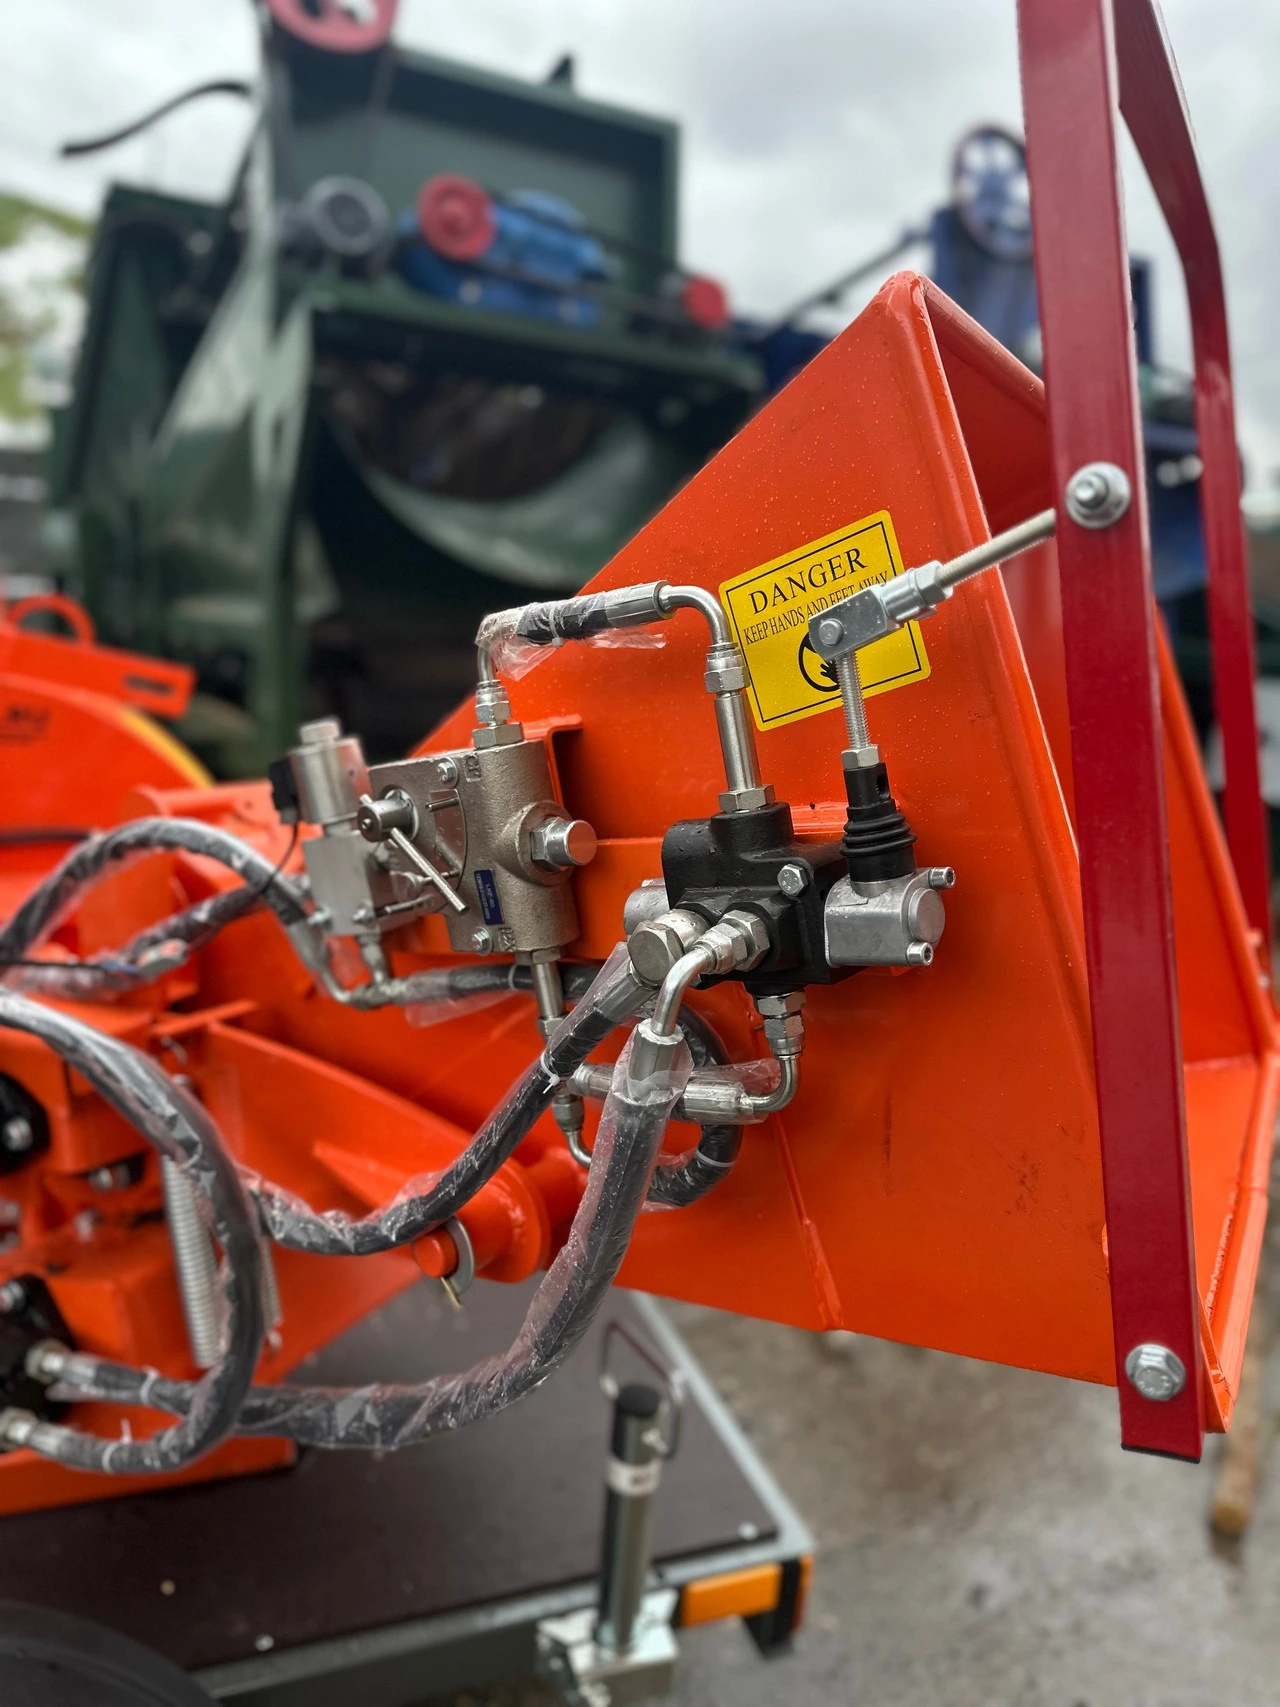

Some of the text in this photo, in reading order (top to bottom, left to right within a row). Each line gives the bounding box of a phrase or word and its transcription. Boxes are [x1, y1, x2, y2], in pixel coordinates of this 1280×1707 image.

[749, 548, 868, 615] DANGER
[743, 621, 768, 645] KEEP
[769, 606, 806, 635] HANDS
[807, 597, 829, 618] AND
